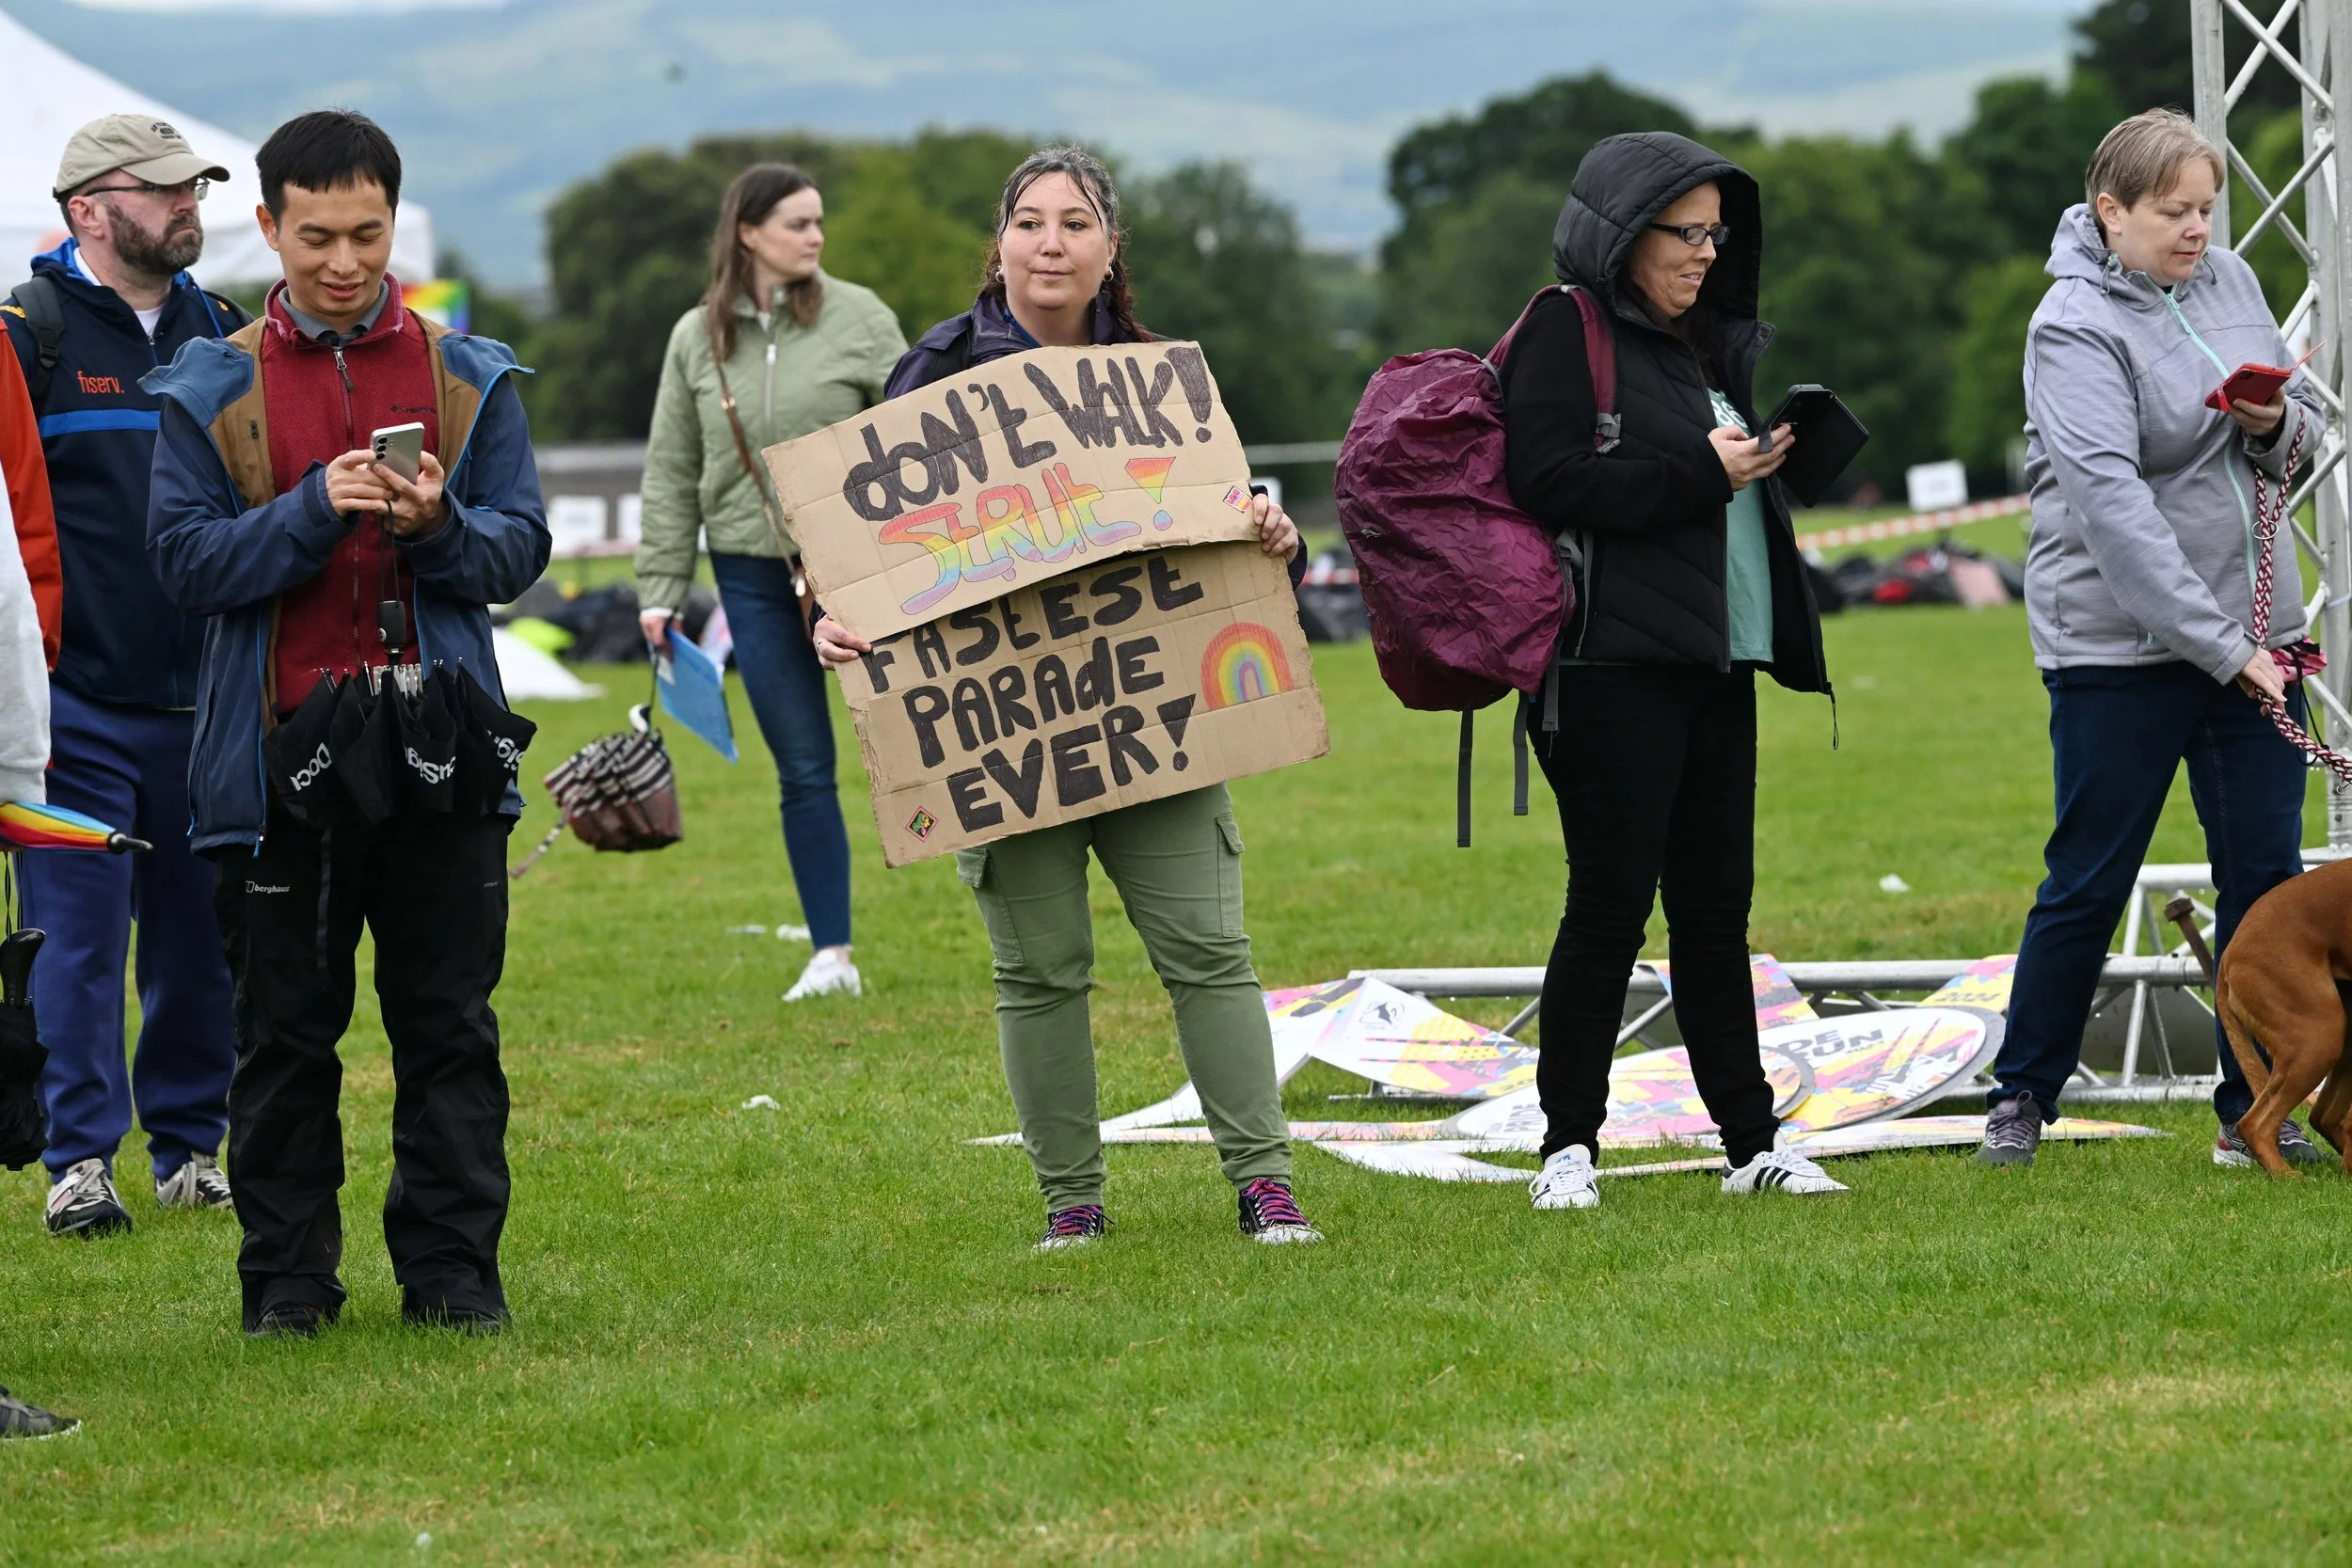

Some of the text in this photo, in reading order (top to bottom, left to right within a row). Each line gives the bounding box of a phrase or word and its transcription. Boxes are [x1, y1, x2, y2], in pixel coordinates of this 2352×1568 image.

[1024, 346, 1212, 450] WALK!
[946, 693, 1196, 833] EVER!
[254, 884, 290, 894] berghaus
